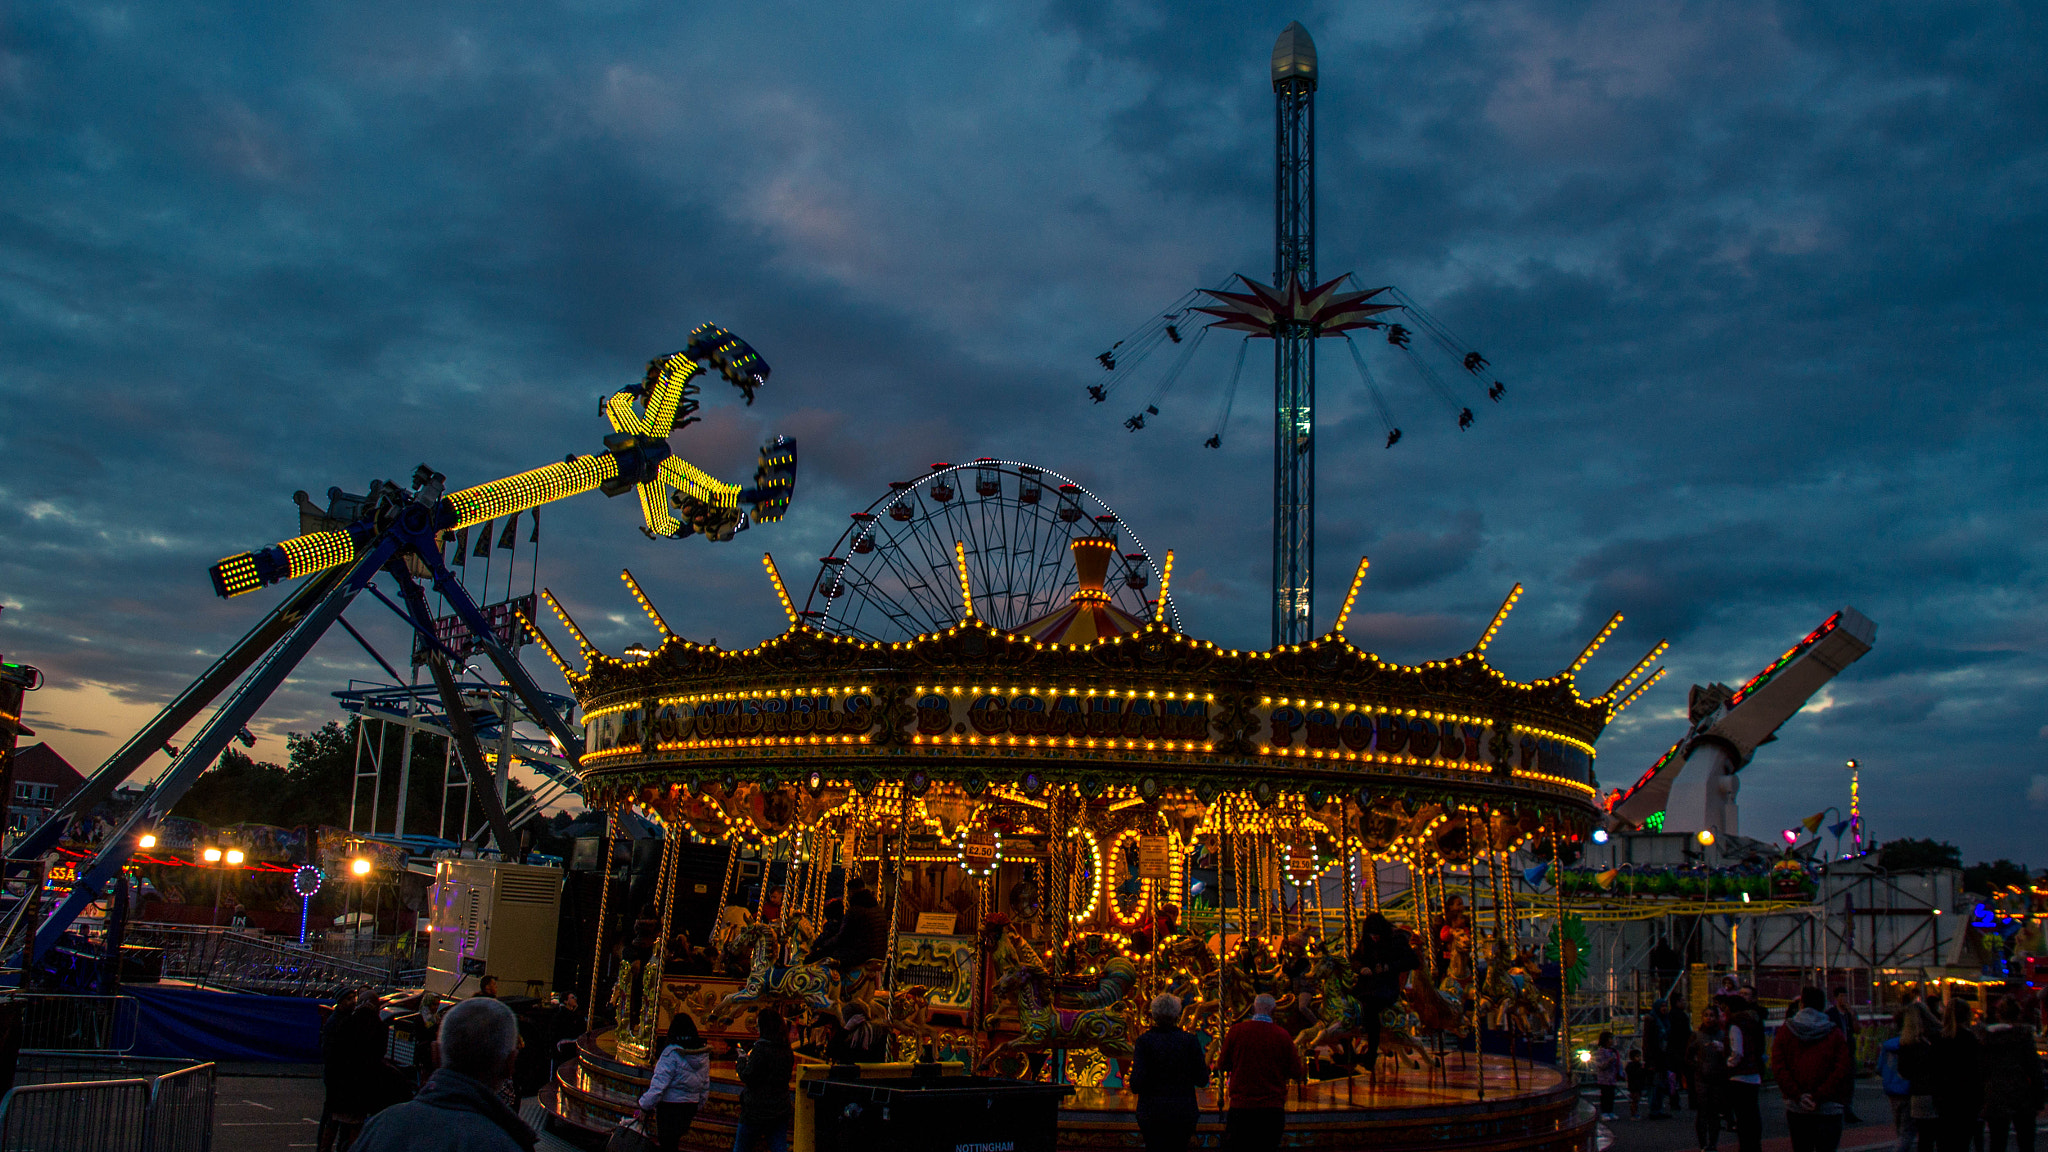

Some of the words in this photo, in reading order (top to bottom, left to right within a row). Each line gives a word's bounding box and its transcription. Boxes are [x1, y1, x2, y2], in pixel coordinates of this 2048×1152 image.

[660, 694, 873, 742] COCKERELS
[967, 694, 1210, 741] GRAHAM
[967, 846, 993, 857] £2.50
[955, 1140, 1015, 1152] NOTTINGHAM
